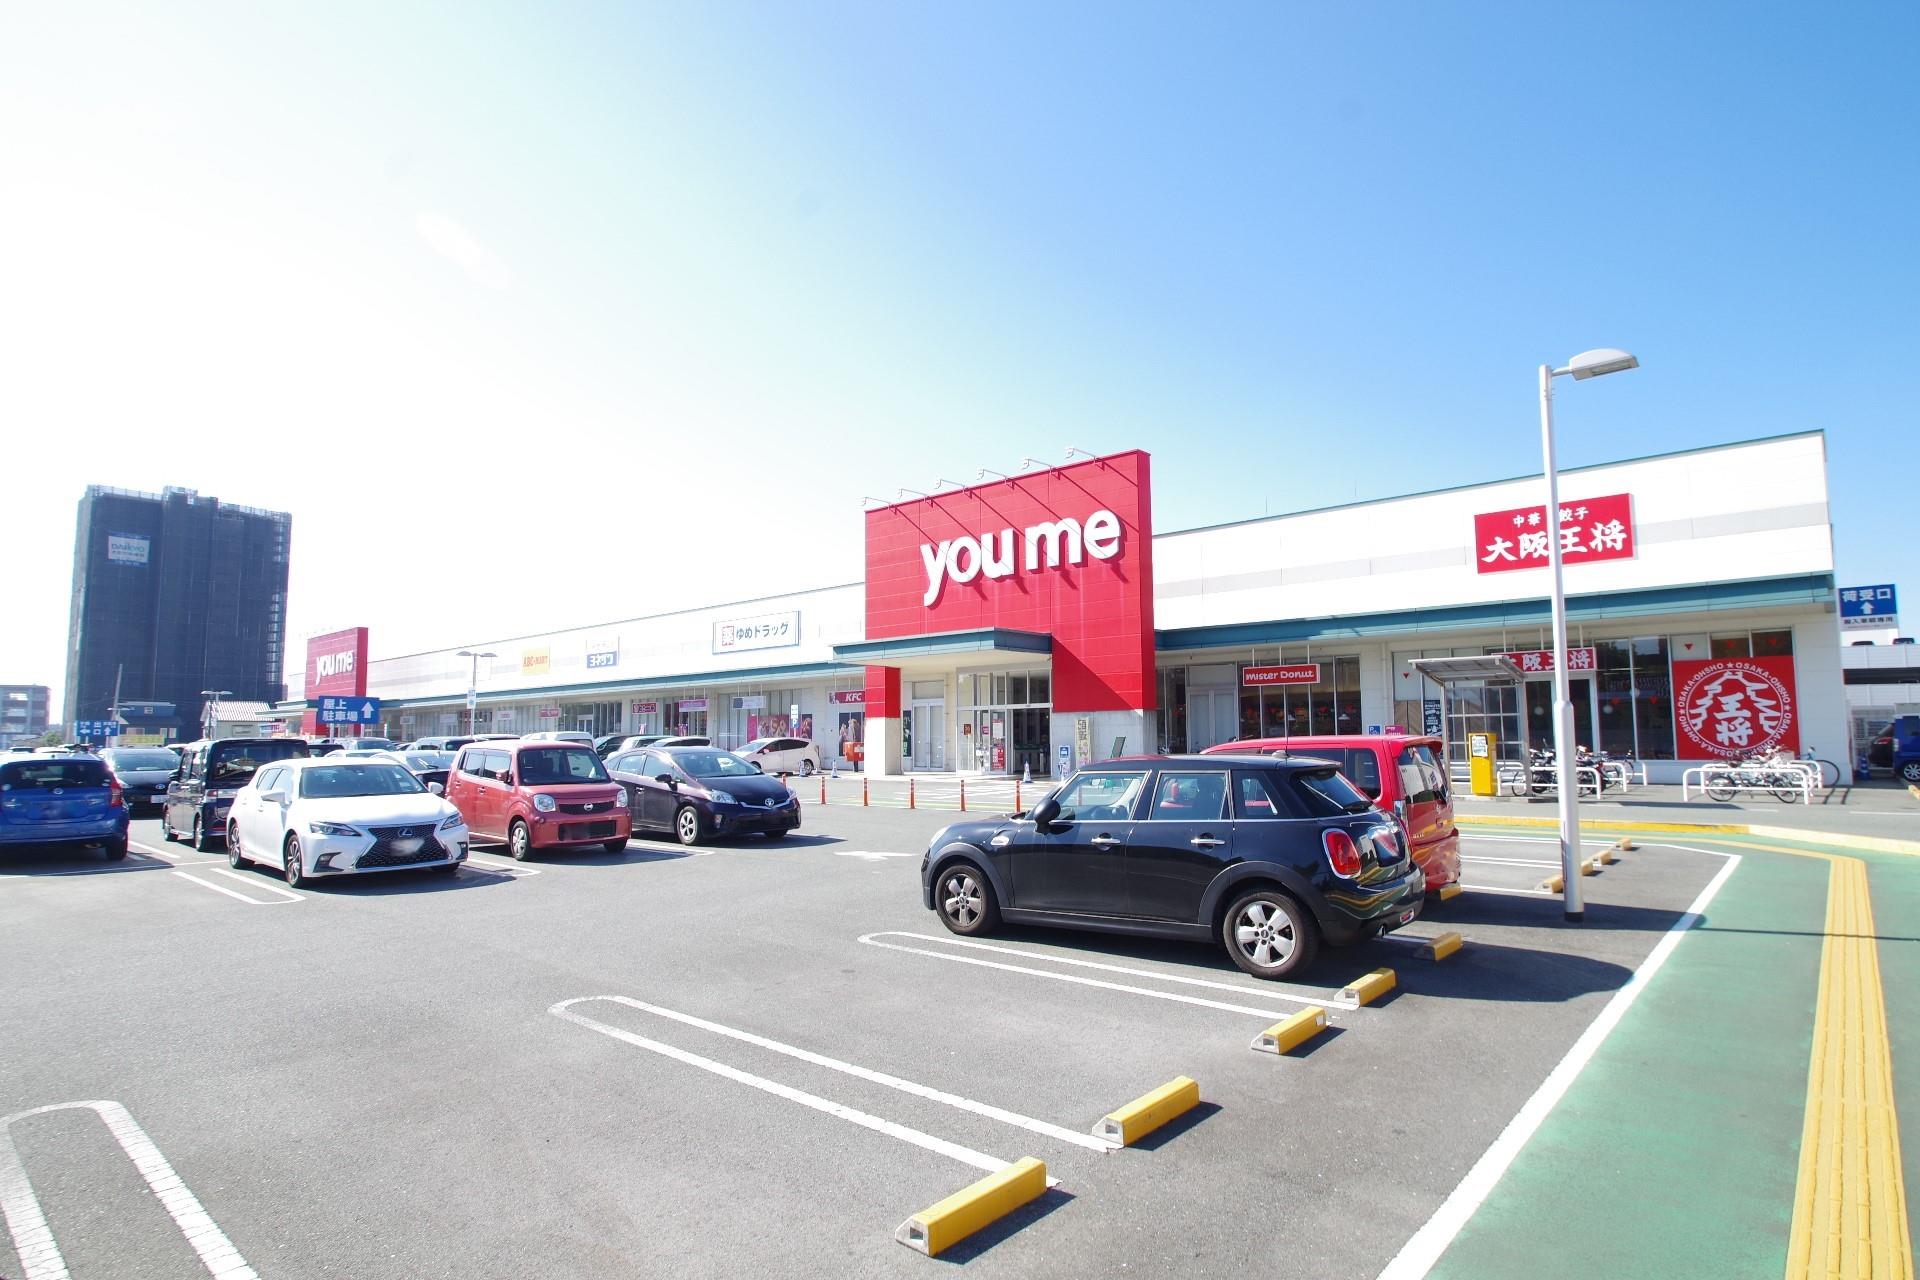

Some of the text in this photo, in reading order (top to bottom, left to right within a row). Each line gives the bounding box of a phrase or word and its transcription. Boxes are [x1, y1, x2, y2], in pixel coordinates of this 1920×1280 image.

[1481, 519, 1628, 563] 大阪王将
[1842, 588, 1891, 602] 荷受口
[736, 622, 789, 640] ゆめドラッグ
[1280, 670, 1314, 679] Donut
[323, 698, 347, 710] 屋上
[845, 692, 862, 704] KFC
[322, 710, 358, 722] 駐車場
[1712, 692, 1755, 746] 王将
